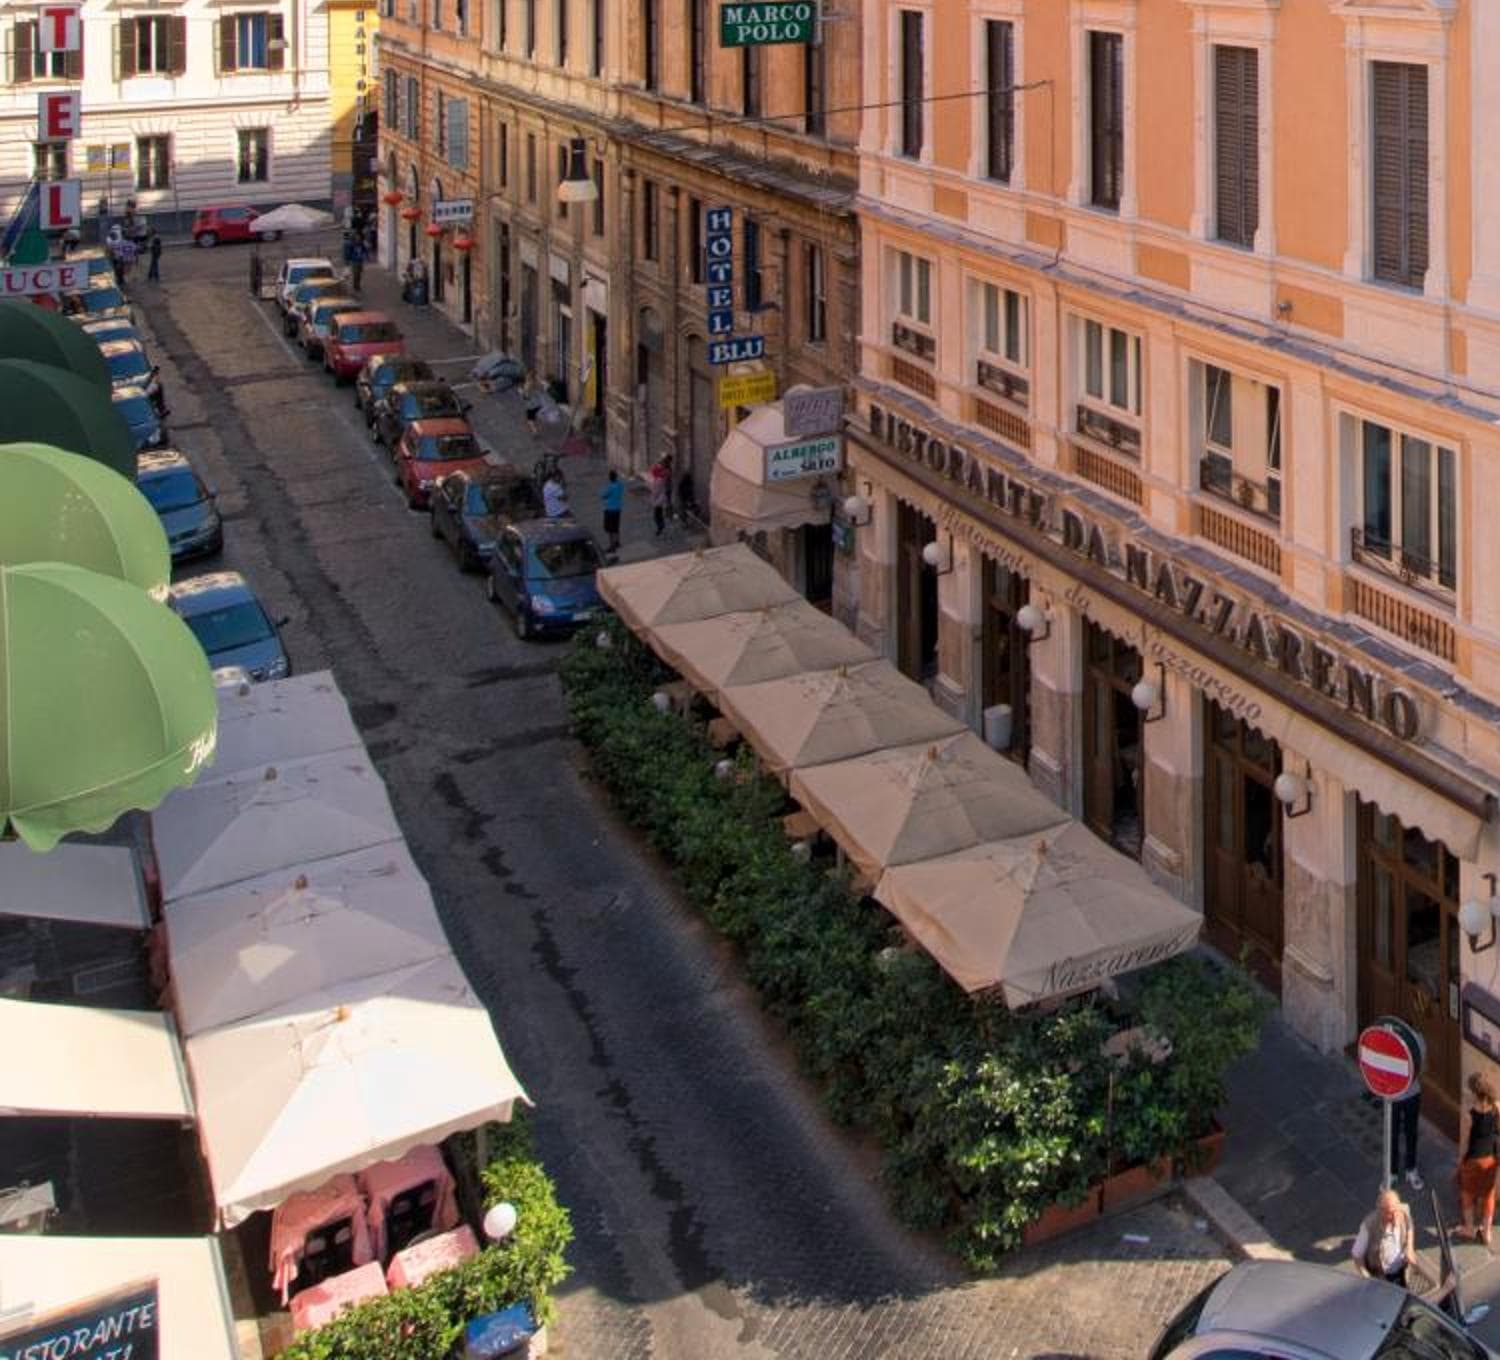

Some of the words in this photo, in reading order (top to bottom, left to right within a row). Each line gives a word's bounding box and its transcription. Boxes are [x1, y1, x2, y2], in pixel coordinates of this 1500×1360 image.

[724, 4, 811, 24] MARCO
[737, 22, 801, 42] POLO
[0, 267, 75, 292] UCE
[711, 212, 732, 332] HOTEL
[712, 341, 763, 363] BLU
[869, 403, 1048, 532] RISTORANTE
[1062, 508, 1109, 566] DA
[1125, 542, 1422, 740] NAZZARENO
